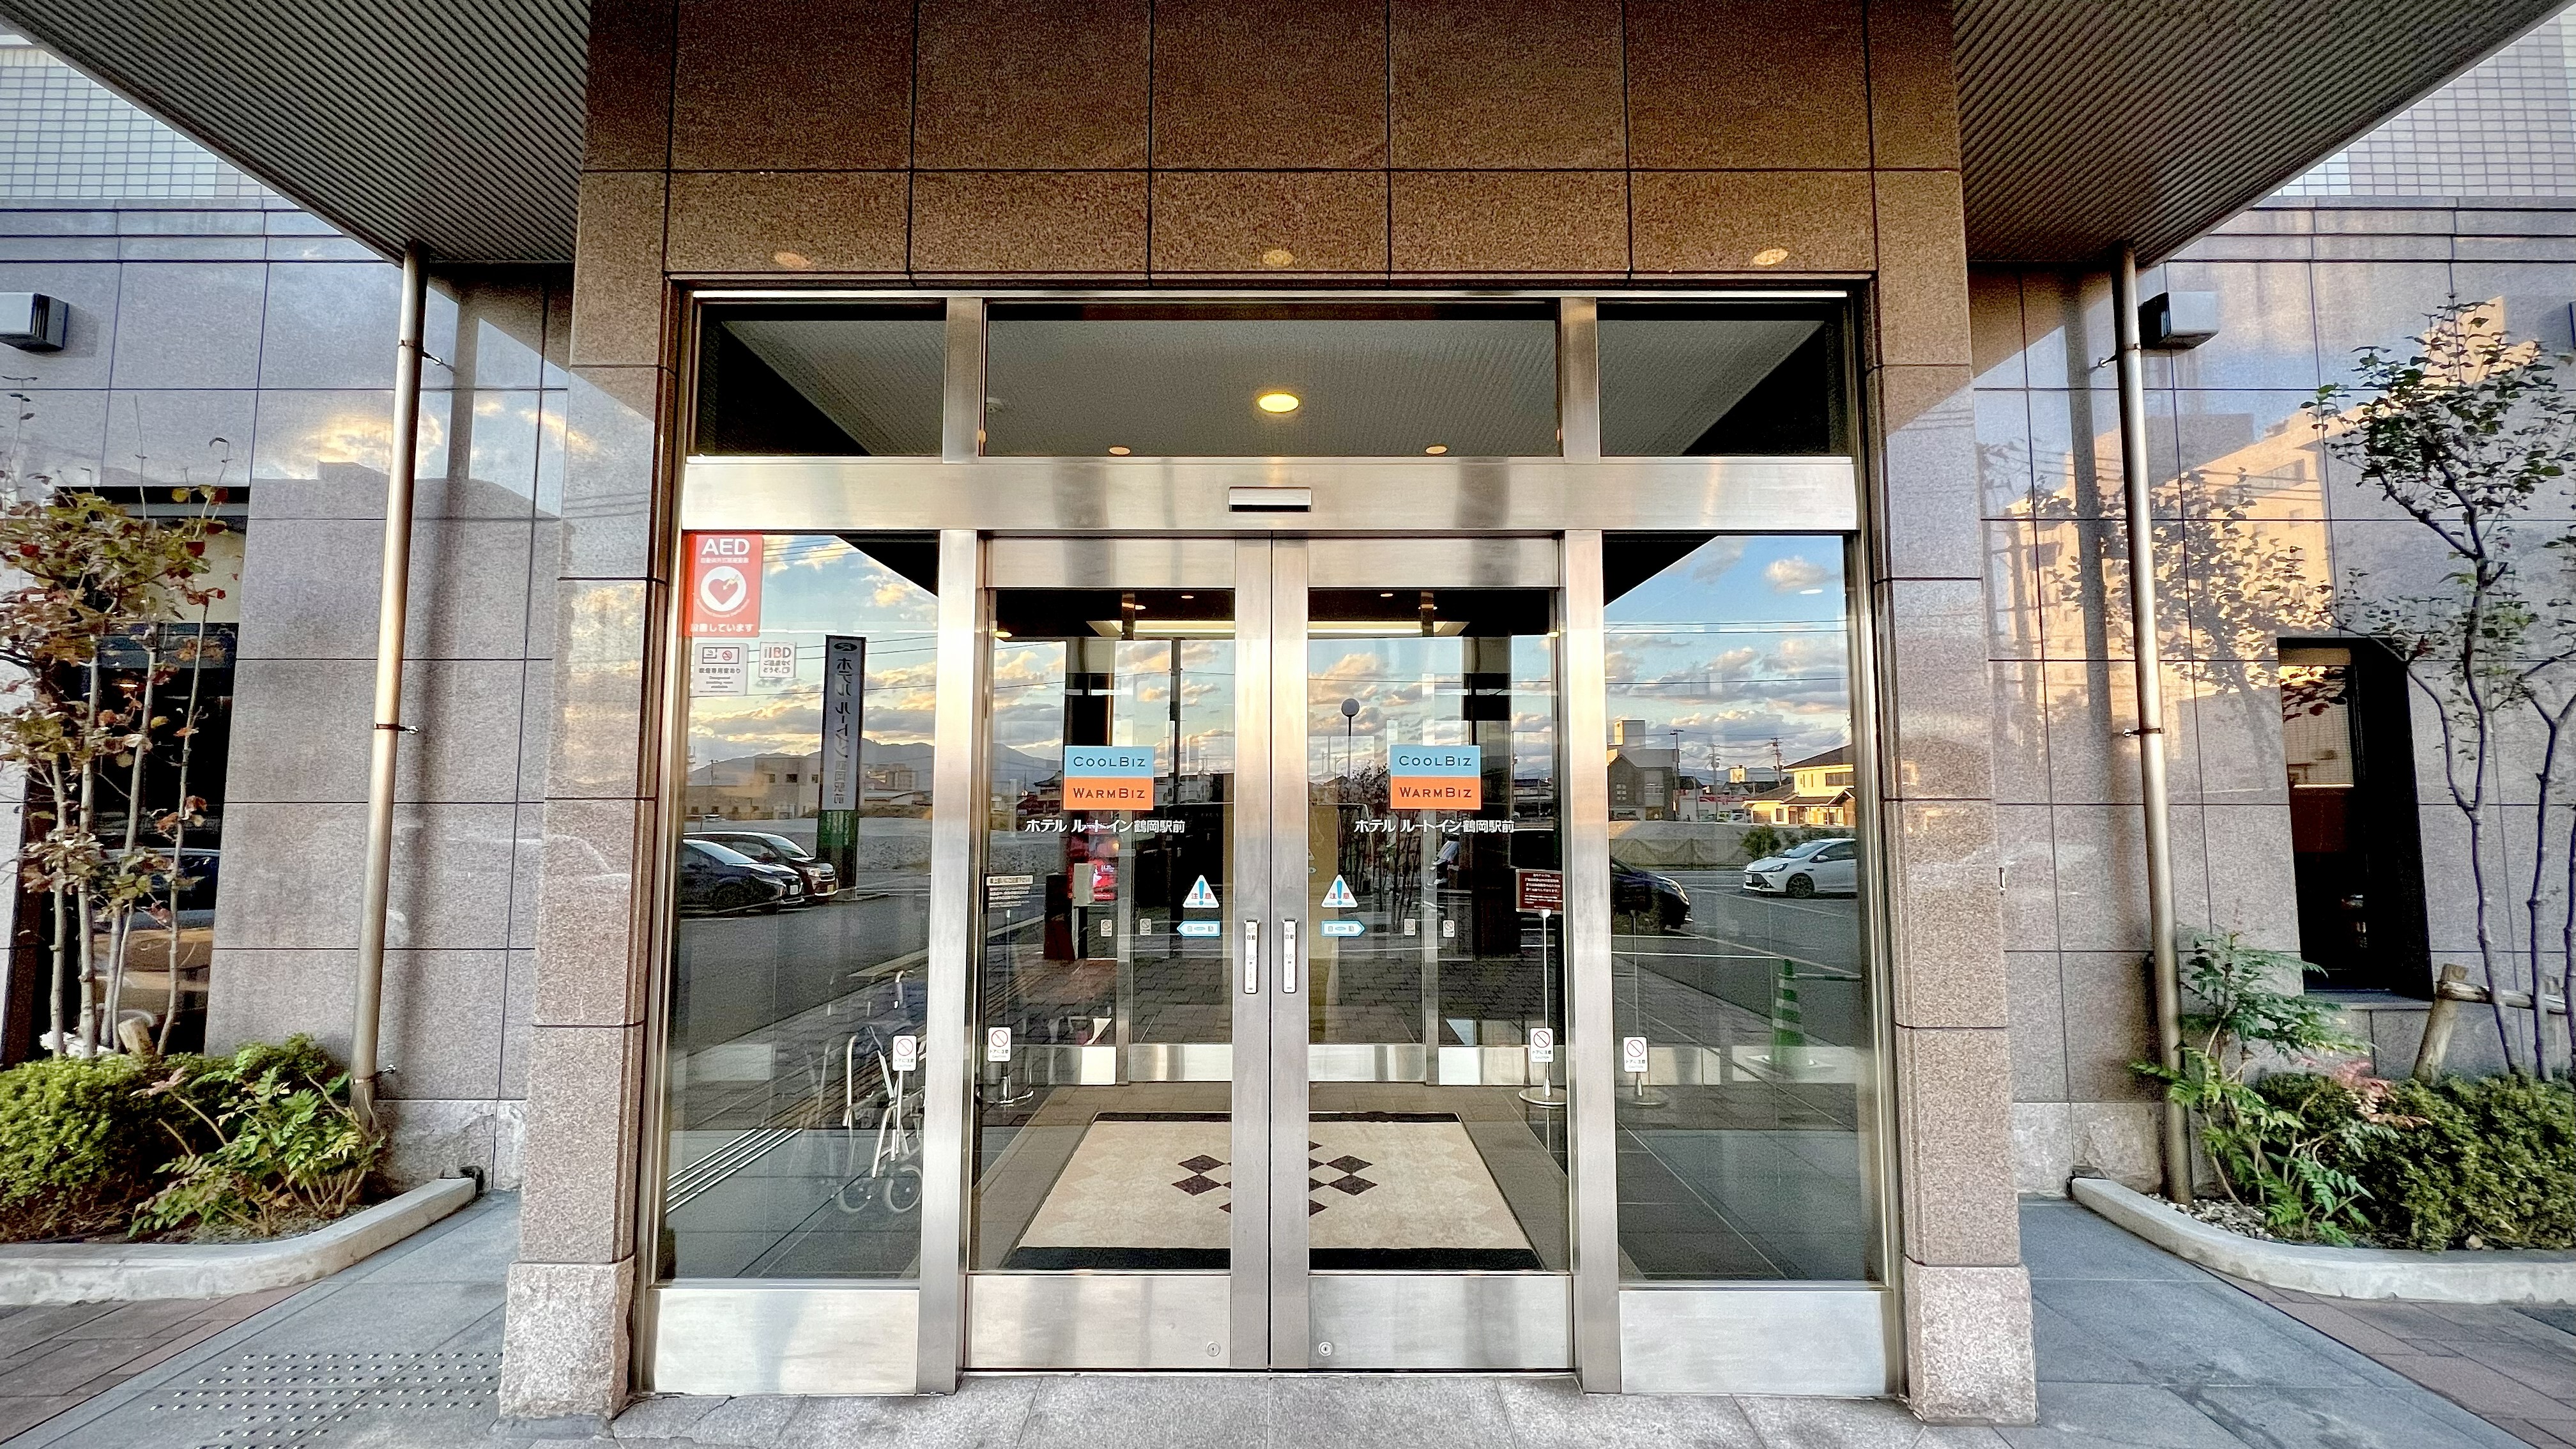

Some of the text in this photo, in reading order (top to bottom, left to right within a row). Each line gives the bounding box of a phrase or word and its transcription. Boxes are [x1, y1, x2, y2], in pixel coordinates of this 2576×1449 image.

[702, 538, 750, 555] AED
[1024, 819, 1068, 833] ホテル
[1354, 819, 1397, 833] ホテル
